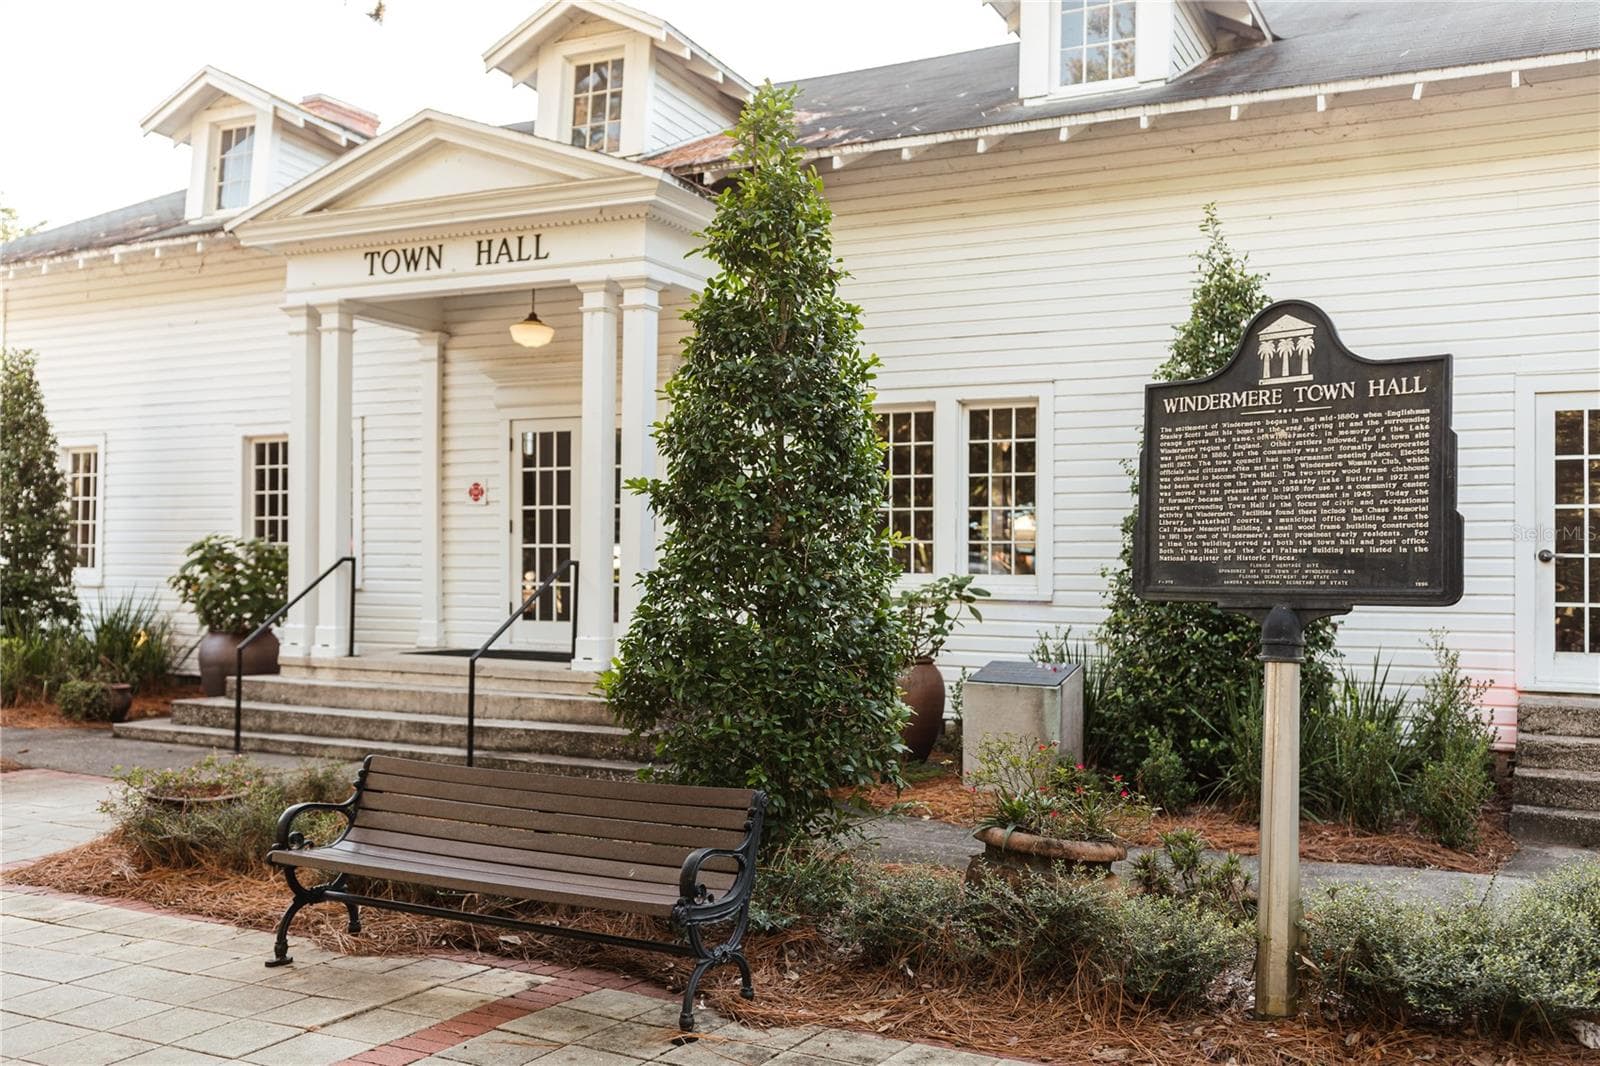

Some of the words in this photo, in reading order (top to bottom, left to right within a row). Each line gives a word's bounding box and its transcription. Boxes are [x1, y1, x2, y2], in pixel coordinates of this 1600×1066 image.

[364, 244, 444, 276] TOWN
[475, 233, 550, 266] HALL
[1163, 388, 1283, 414] WINDERMERE
[1293, 381, 1355, 403] TOWN
[1368, 375, 1427, 397] HALL
[1387, 408, 1430, 419] Englishman
[1309, 422, 1333, 431] giving
[1384, 416, 1430, 426] surrounding
[1262, 448, 1301, 456] community
[1339, 443, 1372, 452] formally
[1378, 440, 1429, 450] incorporated
[1294, 454, 1332, 462] permanent
[1356, 482, 1397, 491] community
[1384, 489, 1409, 498] Today
[1353, 514, 1385, 522] building
[1346, 522, 1376, 530] building
